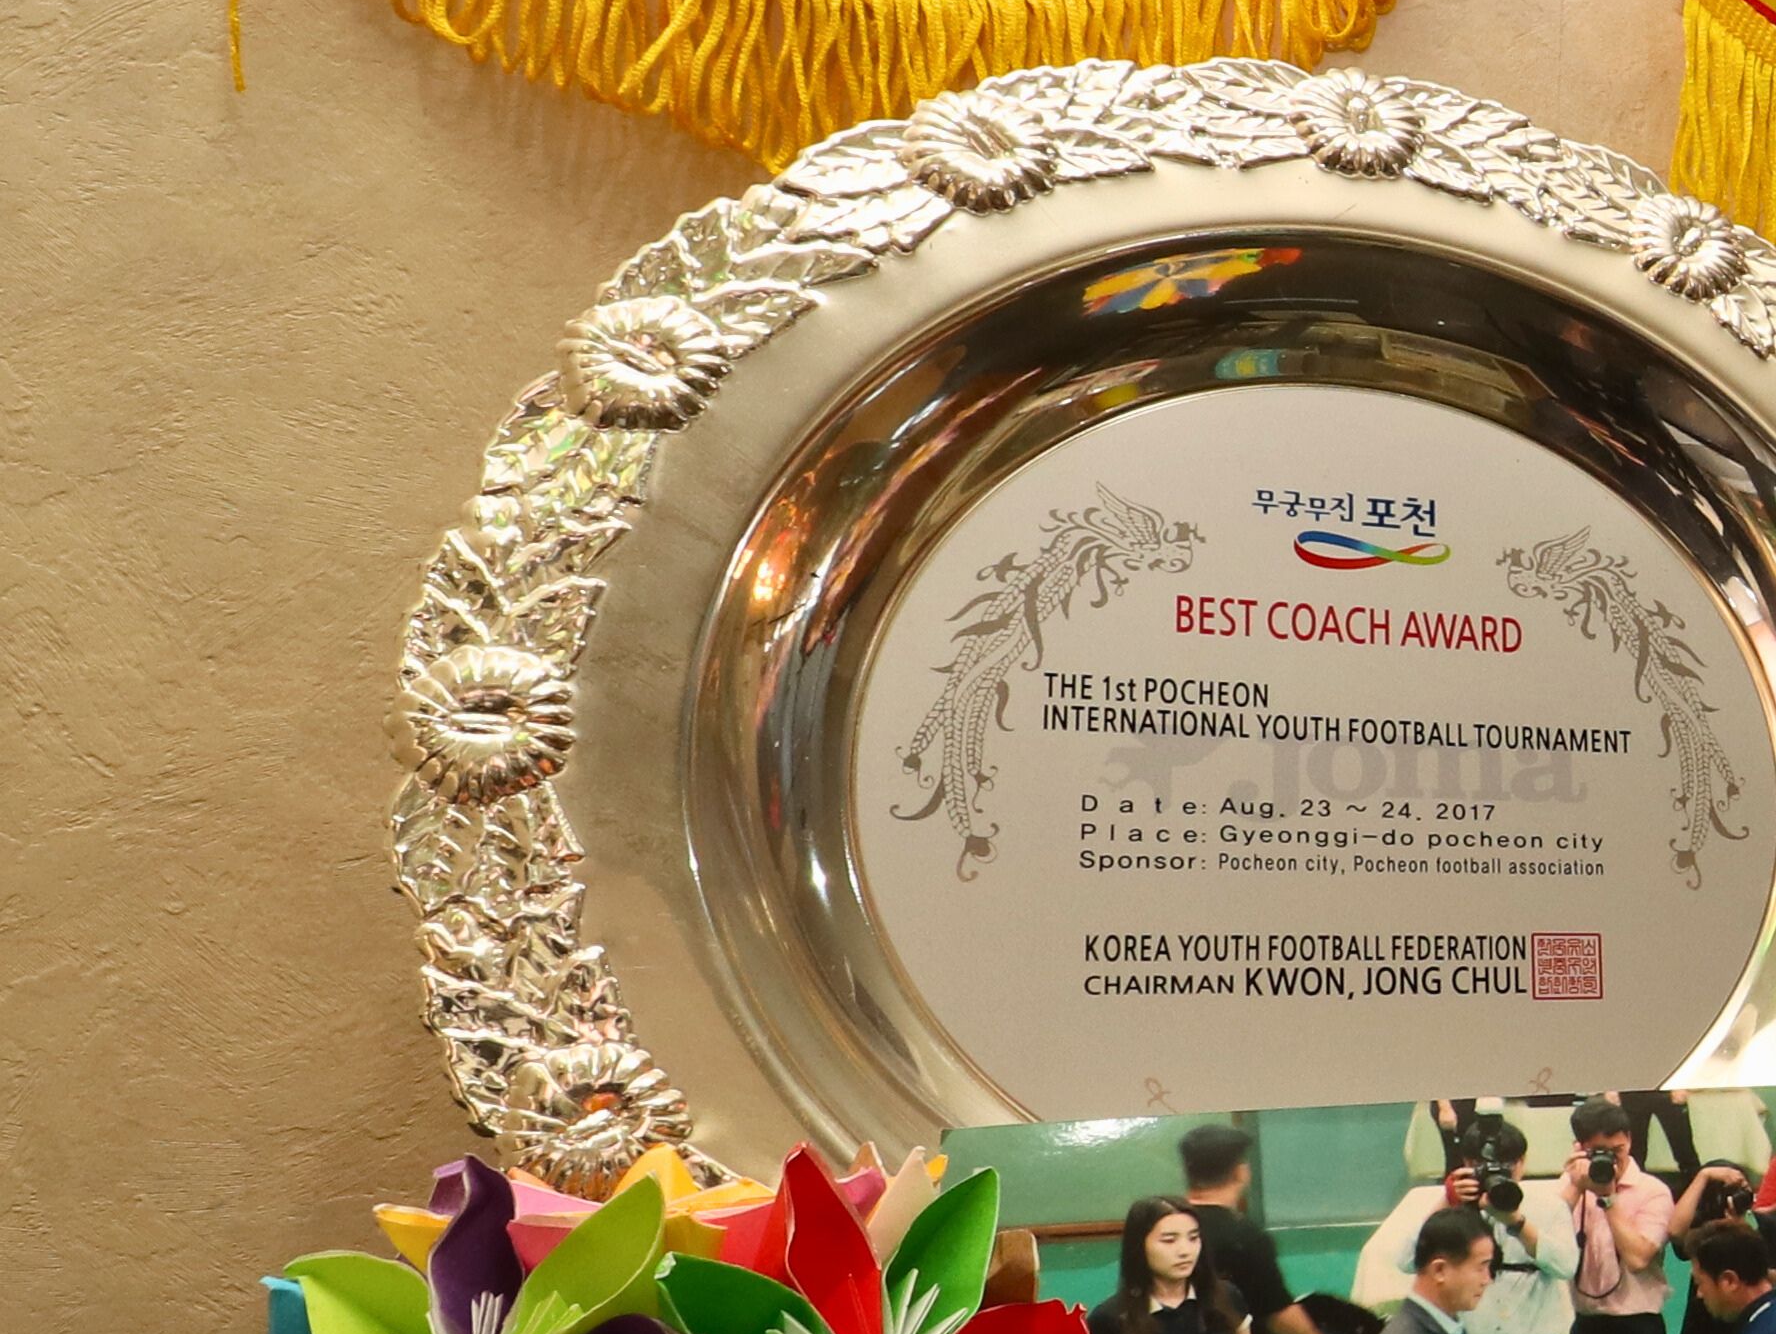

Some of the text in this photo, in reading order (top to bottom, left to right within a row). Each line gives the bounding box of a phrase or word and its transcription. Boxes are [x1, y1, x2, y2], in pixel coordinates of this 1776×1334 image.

[1252, 489, 1438, 537] 무궁무진 포천
[1175, 596, 1522, 653] BEST COACH AWARD
[1044, 673, 1269, 708] THE 1st POCHEON
[1043, 705, 1632, 754] INTERNATIONAL YOUTH FOOTBALL TOURNAMENT
[1219, 797, 1286, 819] Aug.
[1300, 799, 1332, 817] 23
[1381, 801, 1422, 821] 24.
[1436, 803, 1496, 821] 2017
[1219, 824, 1414, 848] Gyeonggi-do
[1427, 829, 1544, 850] pocheon
[1556, 832, 1603, 853] city
[1079, 850, 1605, 877] Sponsor: Pocheon city, Pocheon football association
[1085, 934, 1527, 962] KOREA YOUTH FOOTBALL FEDERATION
[1084, 974, 1235, 996] CHAIRMAN
[1245, 967, 1355, 1001] KWON,
[1362, 966, 1442, 997] JONG
[1451, 965, 1528, 995] CHUL
